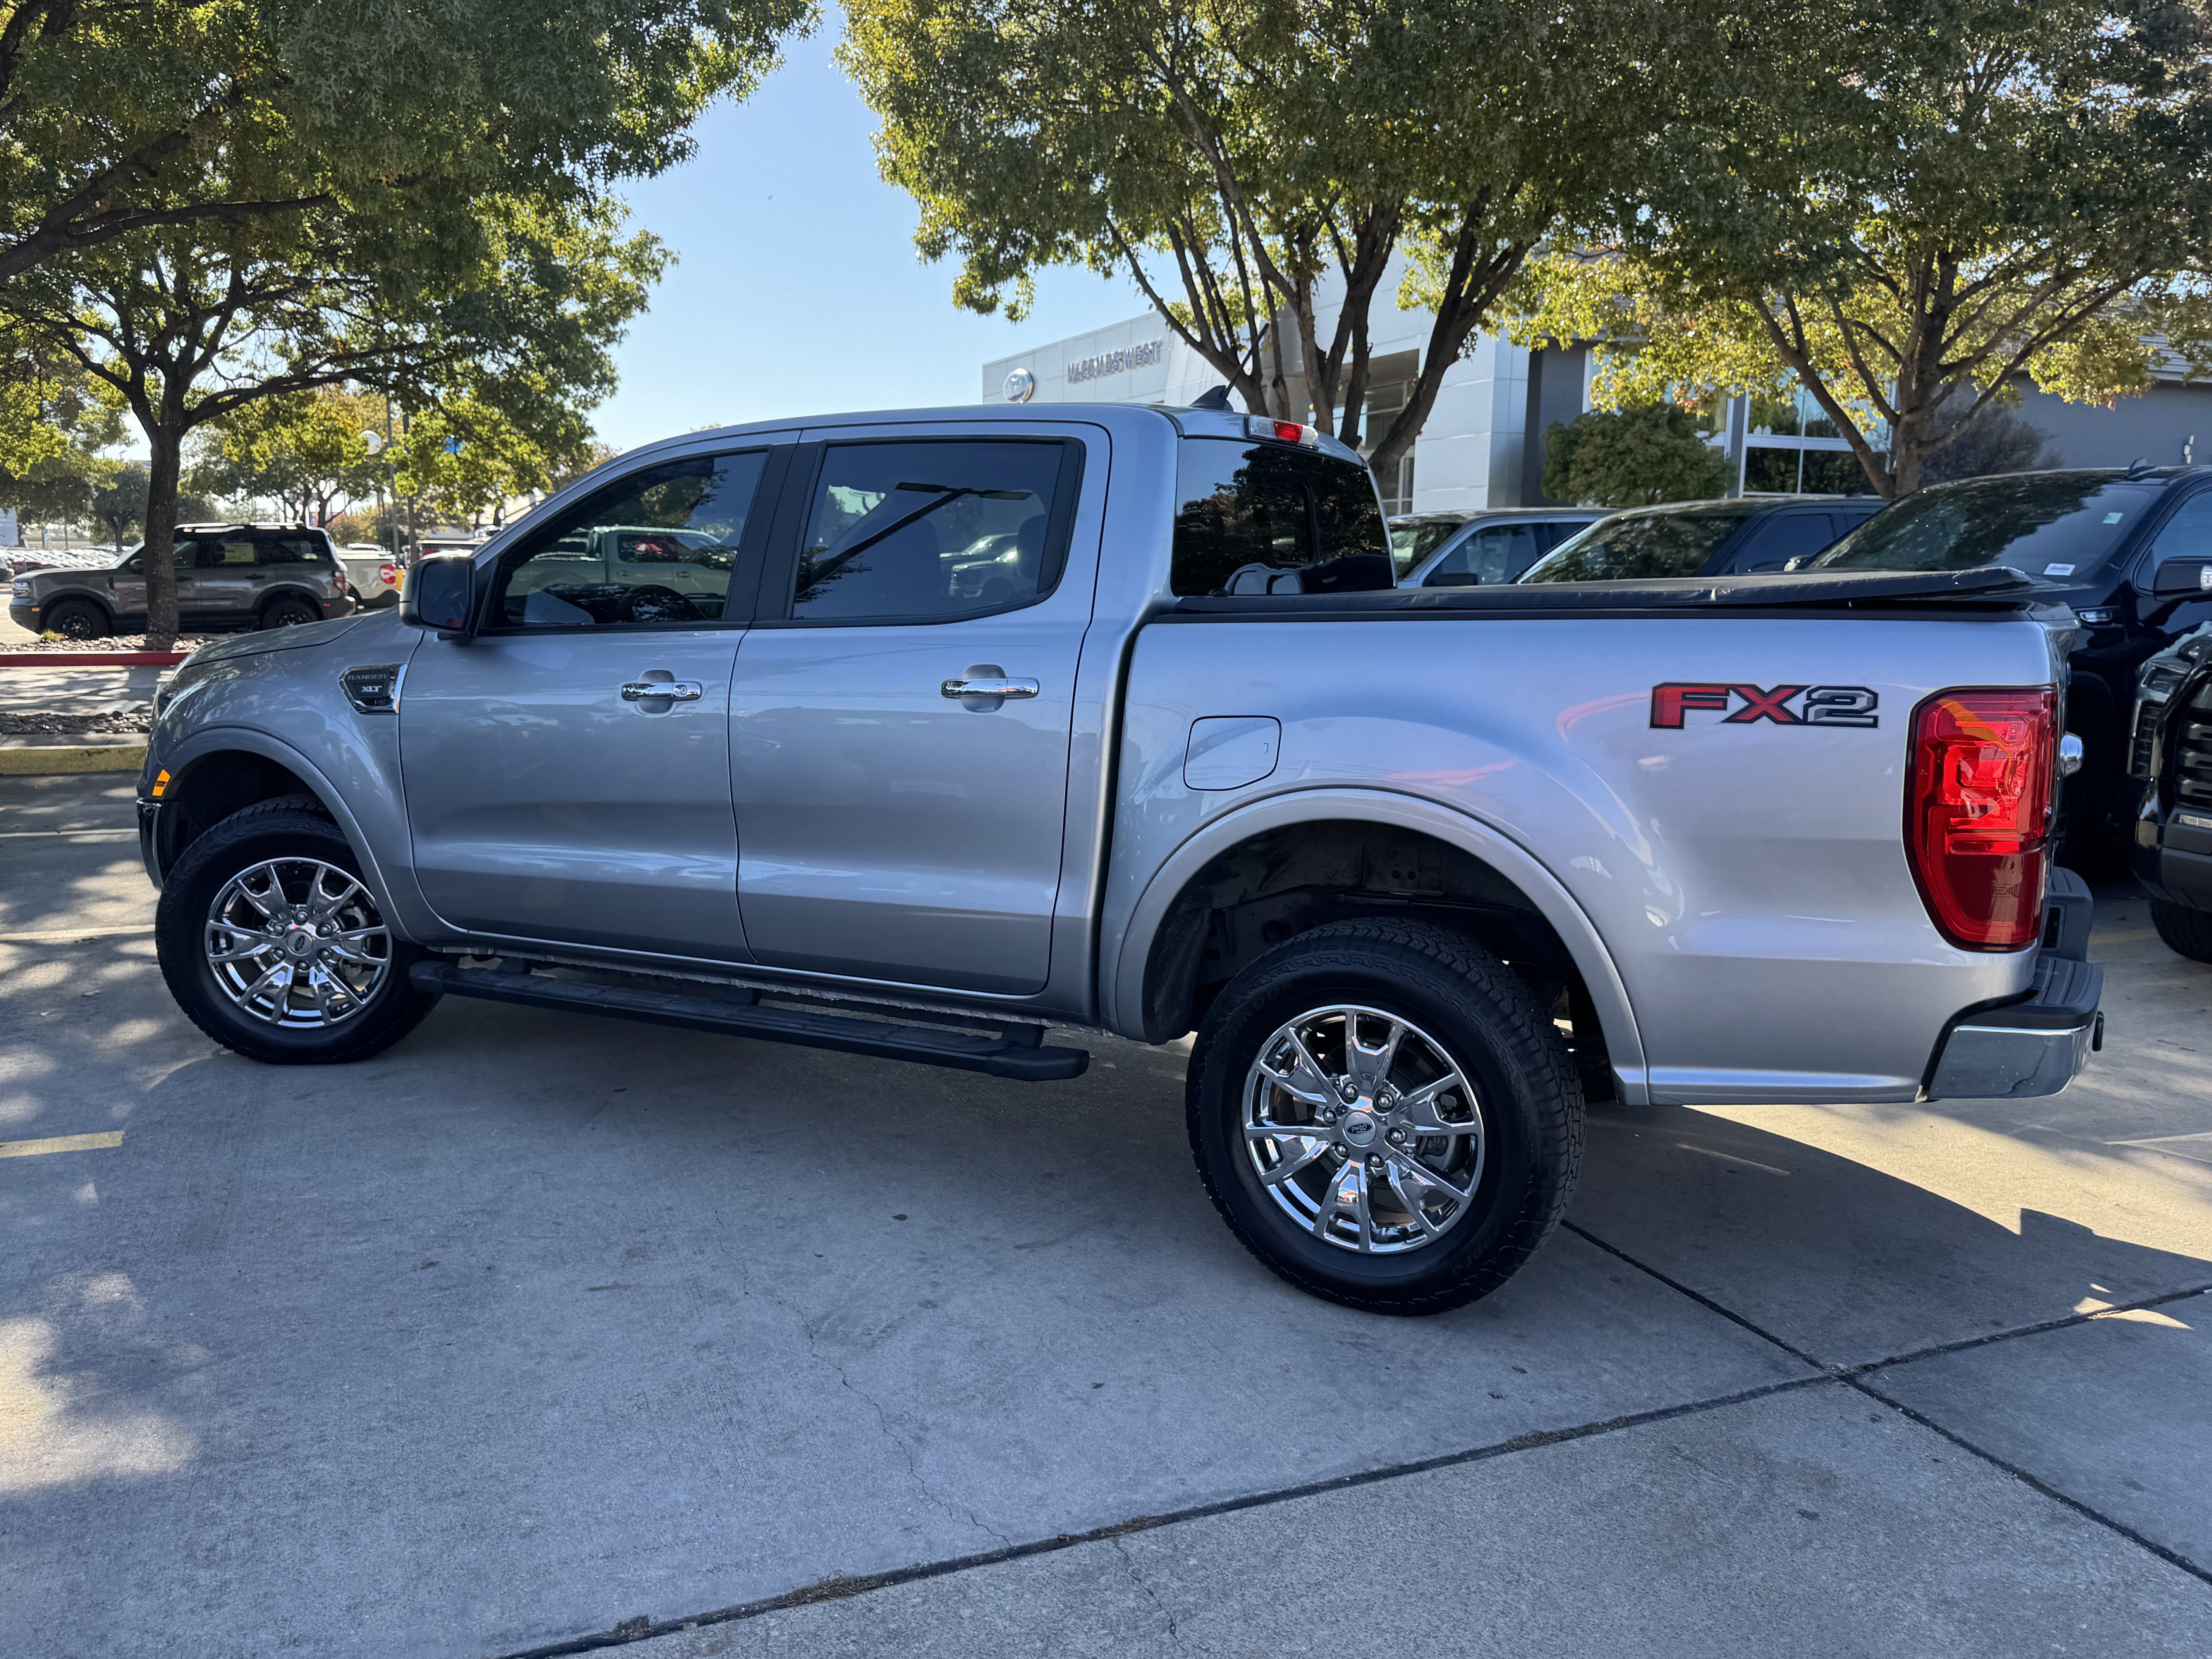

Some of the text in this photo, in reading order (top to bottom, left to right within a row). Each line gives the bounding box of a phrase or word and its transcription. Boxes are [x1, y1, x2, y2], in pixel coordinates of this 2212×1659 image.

[1124, 340, 1161, 369] WEST
[1649, 682, 1879, 729] FX2
[1350, 1124, 1369, 1133] Ford
